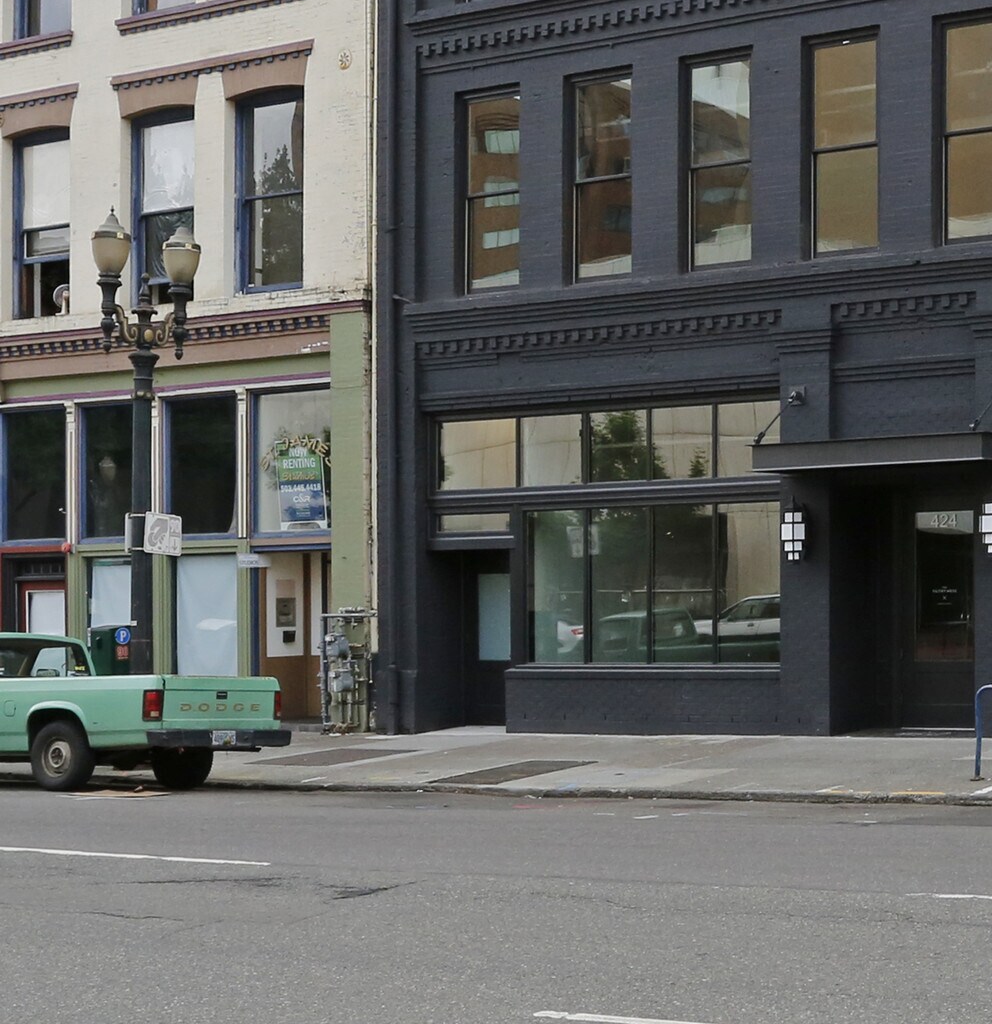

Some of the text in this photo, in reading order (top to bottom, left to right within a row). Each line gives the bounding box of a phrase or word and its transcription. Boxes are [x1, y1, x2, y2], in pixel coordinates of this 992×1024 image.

[288, 447, 308, 458] NOW
[283, 458, 316, 469] RENTING
[930, 513, 958, 528] 424
[180, 703, 261, 712] DODGE
